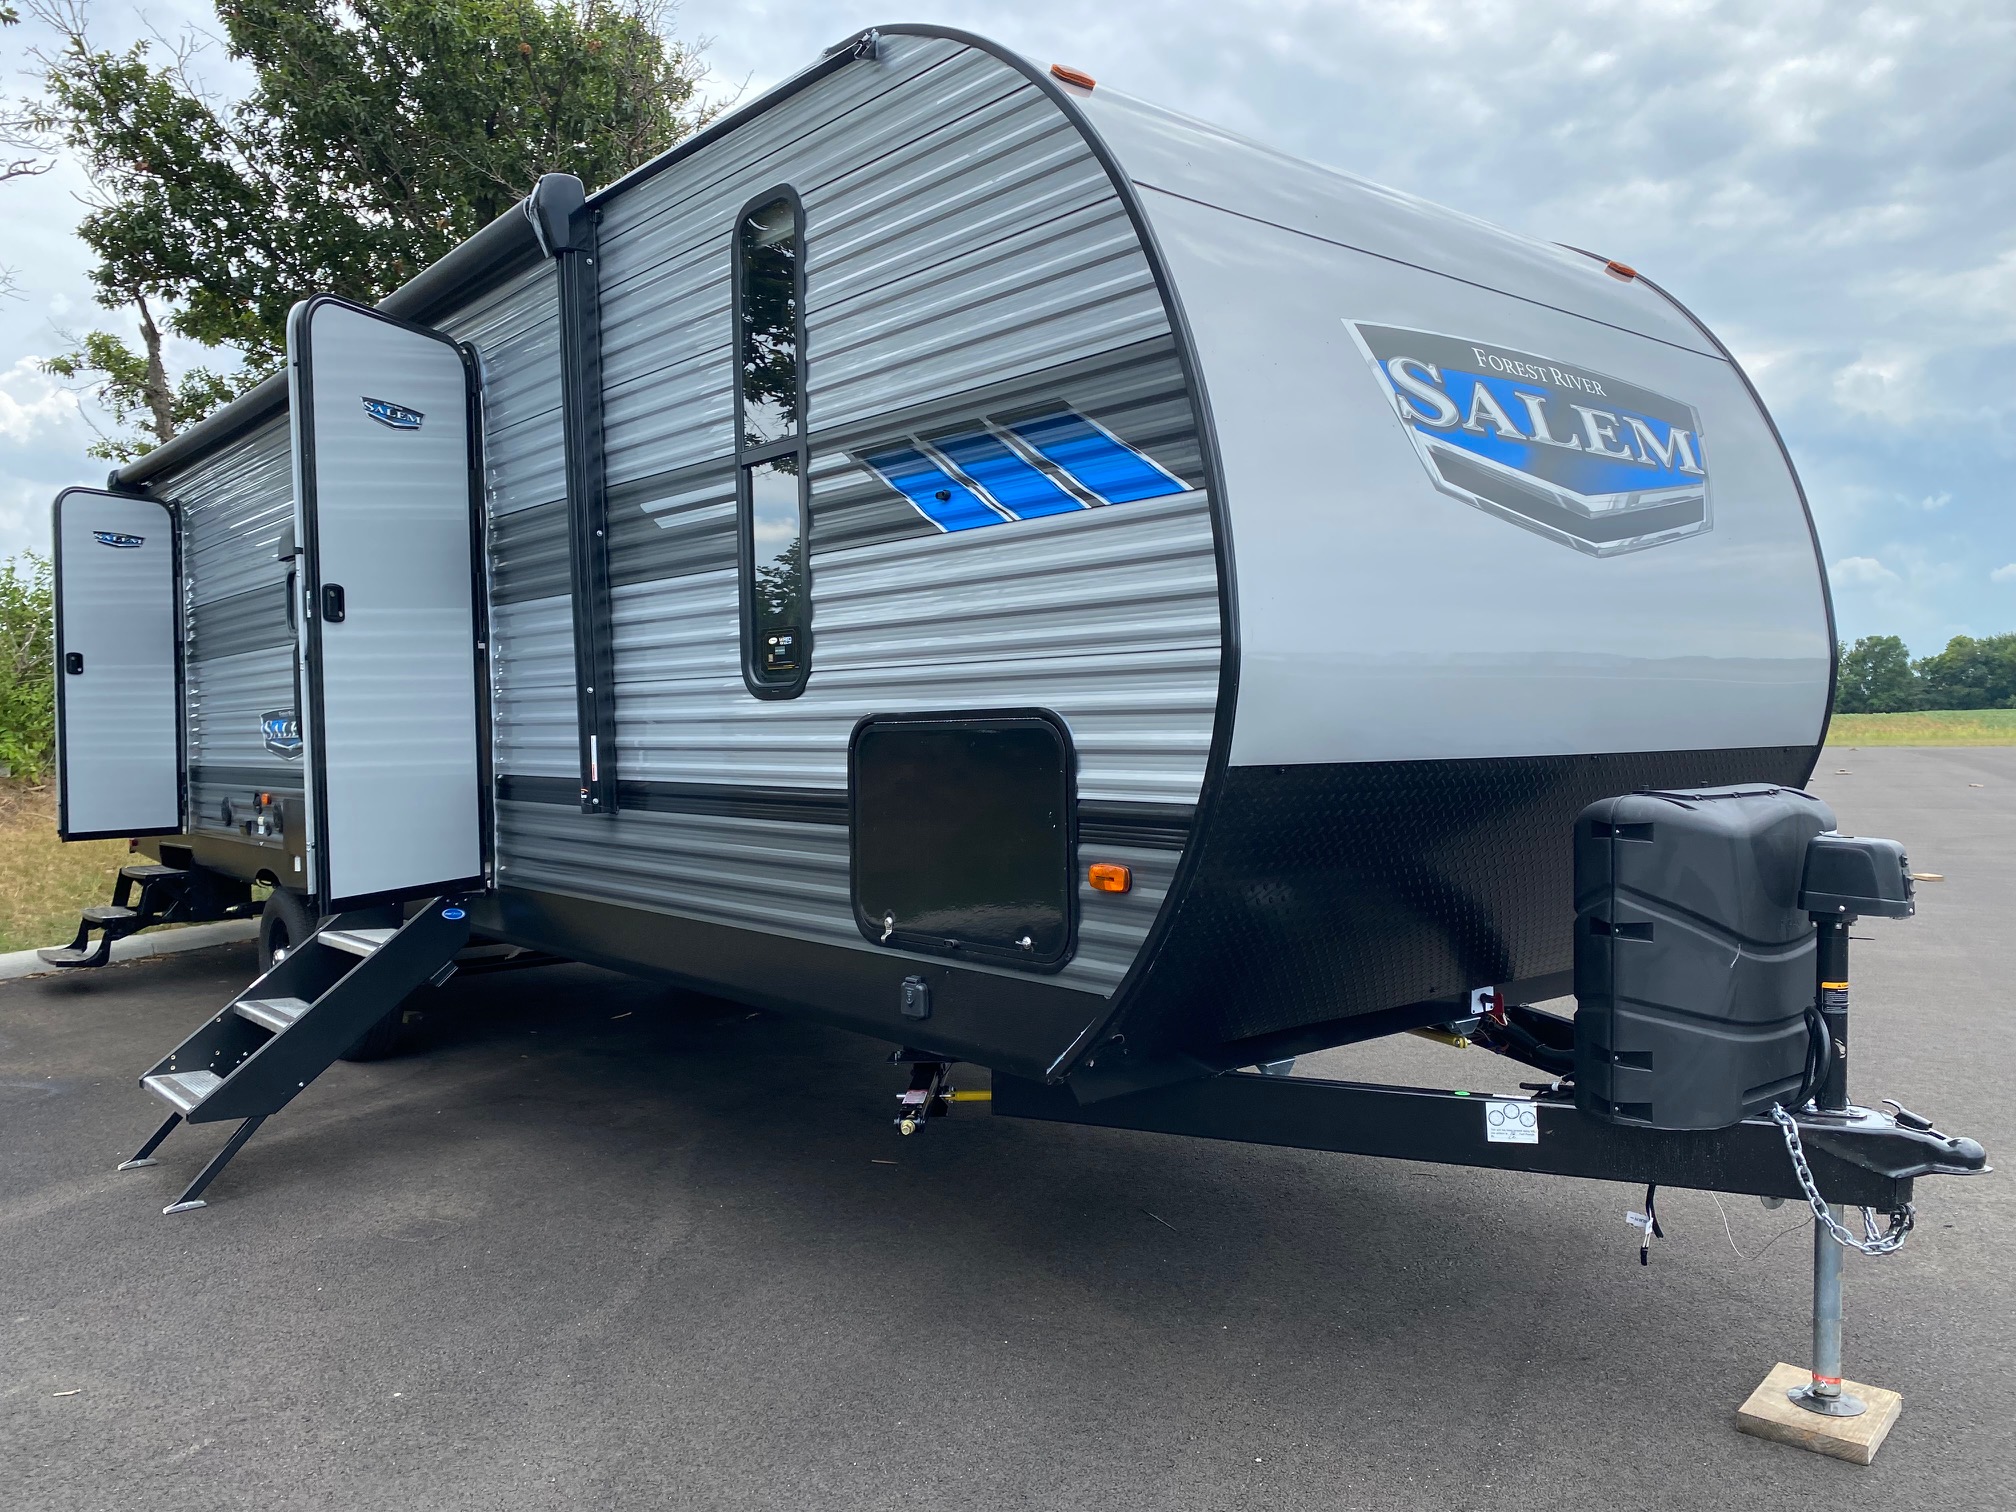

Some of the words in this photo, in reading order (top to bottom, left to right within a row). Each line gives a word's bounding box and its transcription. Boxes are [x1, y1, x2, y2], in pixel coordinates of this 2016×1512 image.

[1471, 347, 1547, 383] FOREST
[1548, 366, 1607, 397] RIVER
[364, 400, 421, 424] SALEM
[1386, 355, 1706, 476] SALEM
[264, 720, 299, 740] SALE
